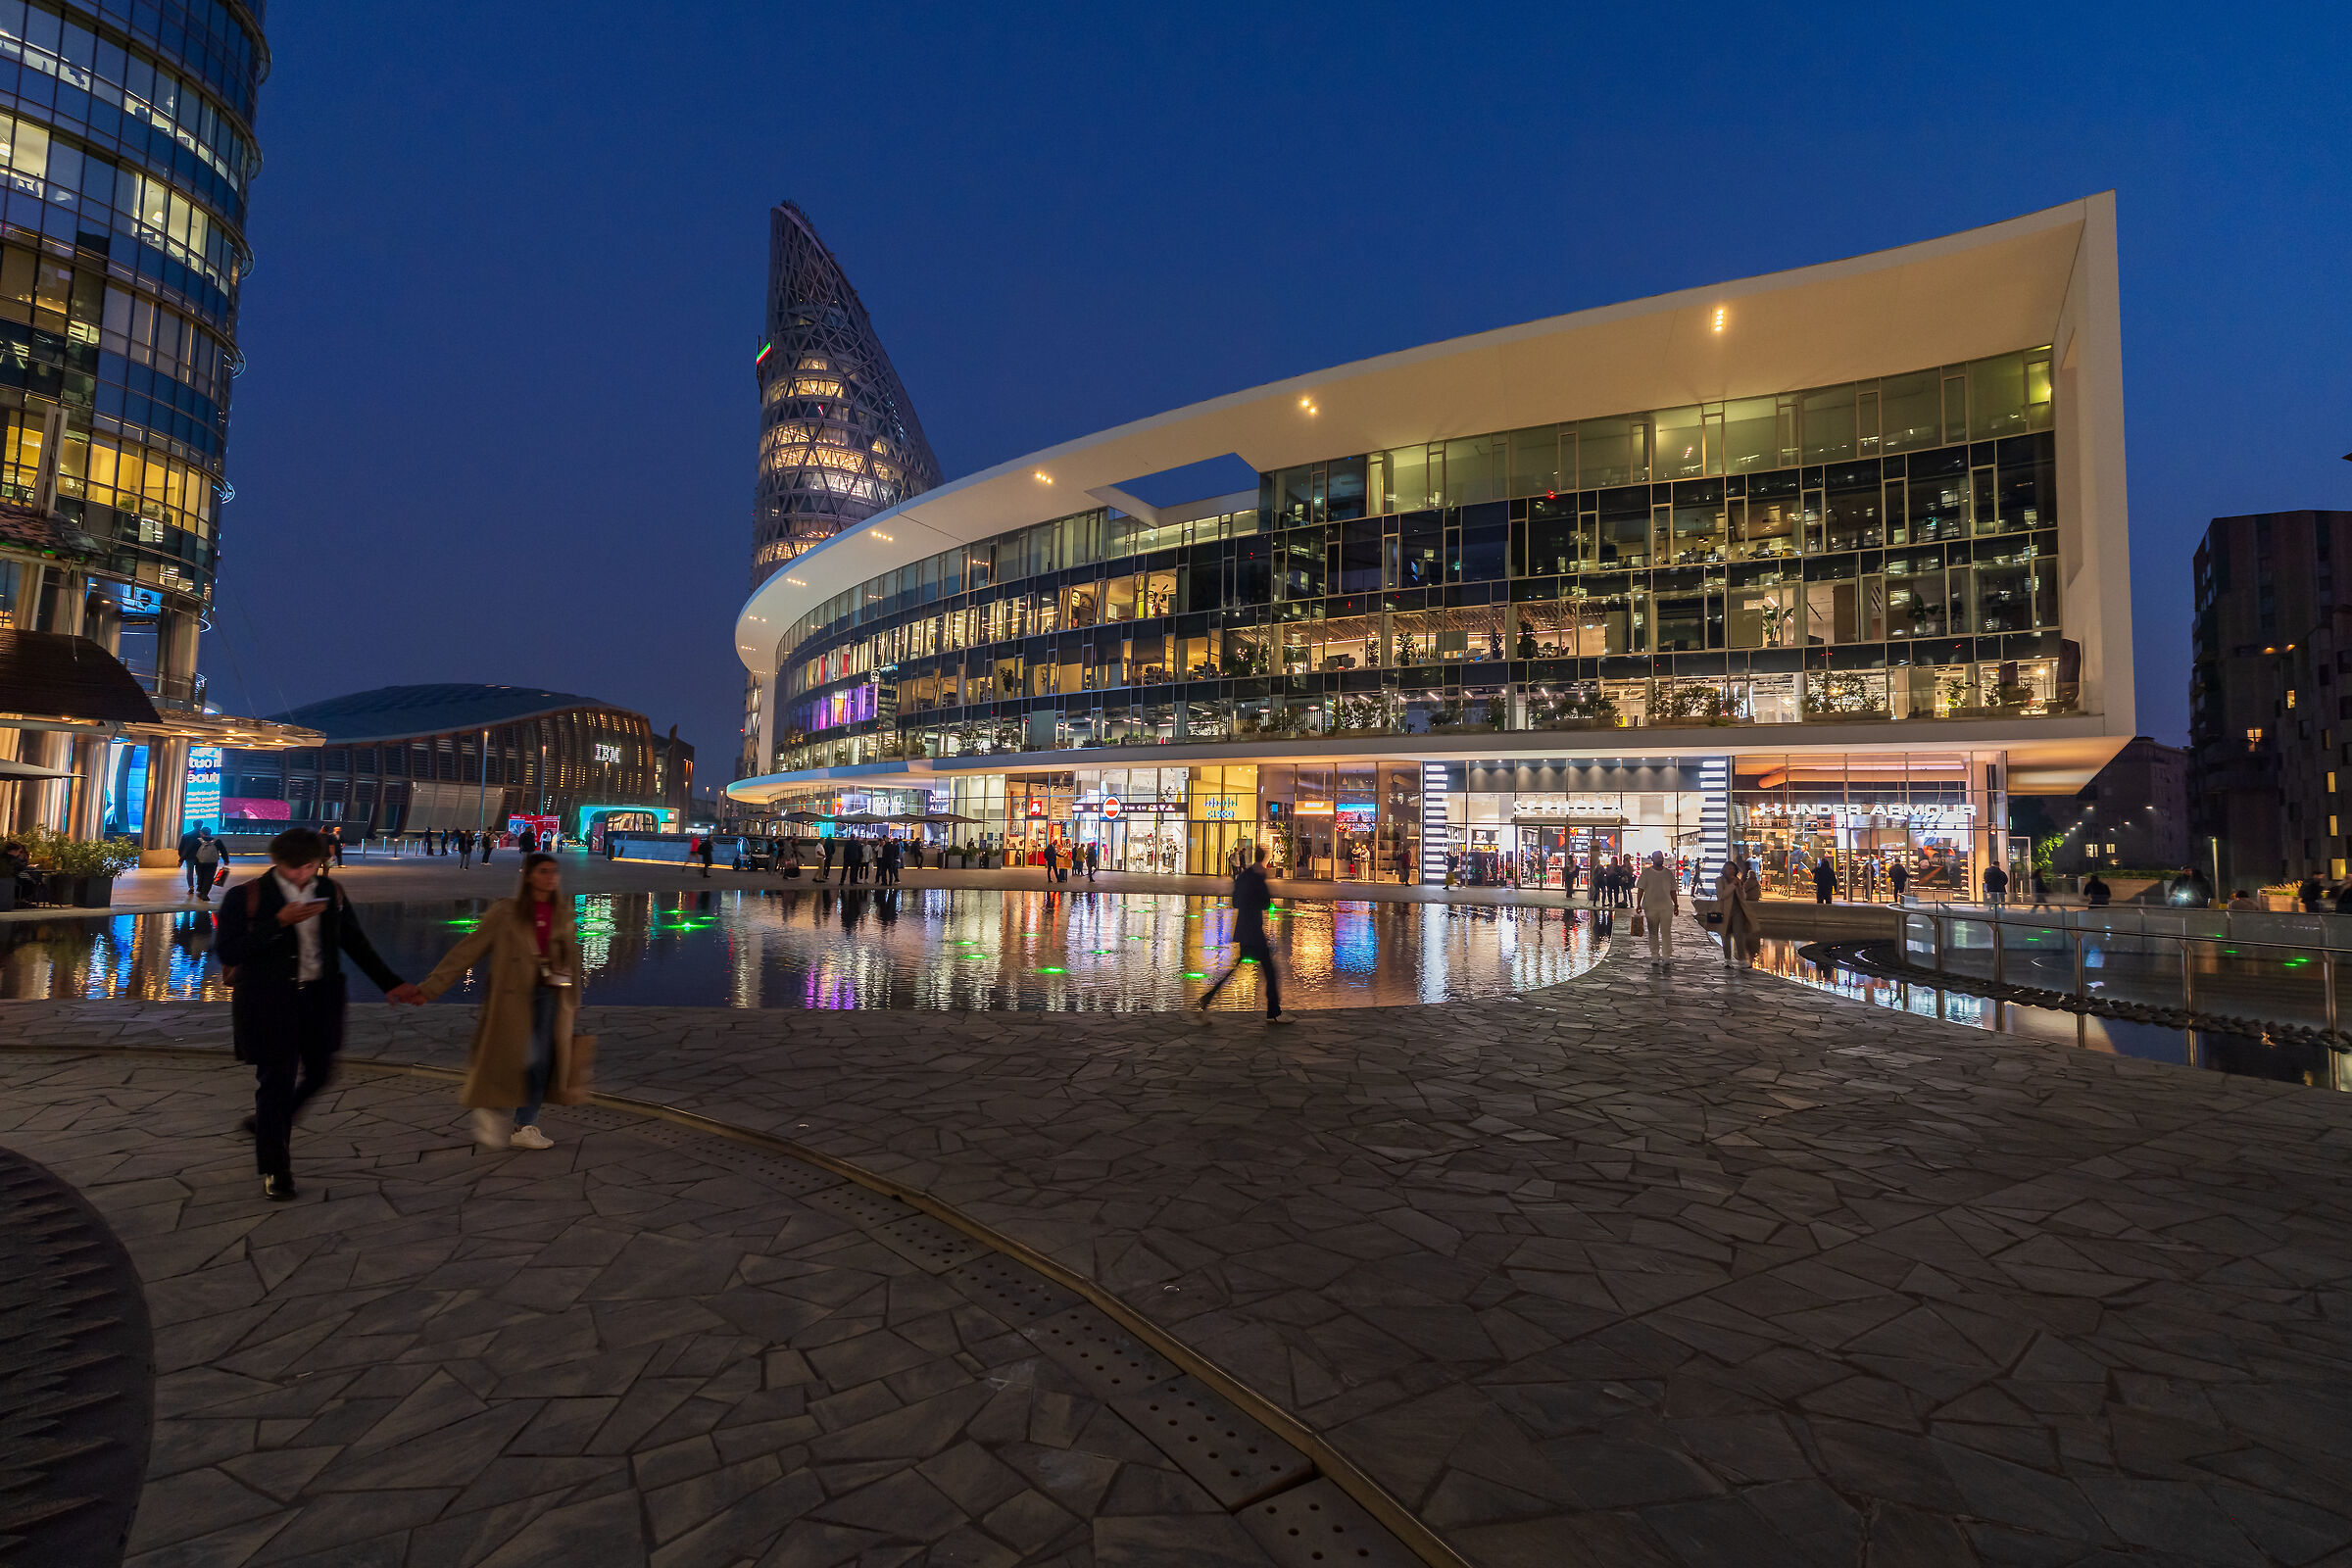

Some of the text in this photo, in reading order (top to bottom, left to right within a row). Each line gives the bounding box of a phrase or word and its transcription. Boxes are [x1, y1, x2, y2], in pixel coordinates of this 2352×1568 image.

[595, 743, 620, 763] IBM
[1206, 809, 1235, 818] CISCO
[1513, 800, 1623, 815] SEPHORA
[1786, 803, 1977, 816] UNDER ARMOUR
